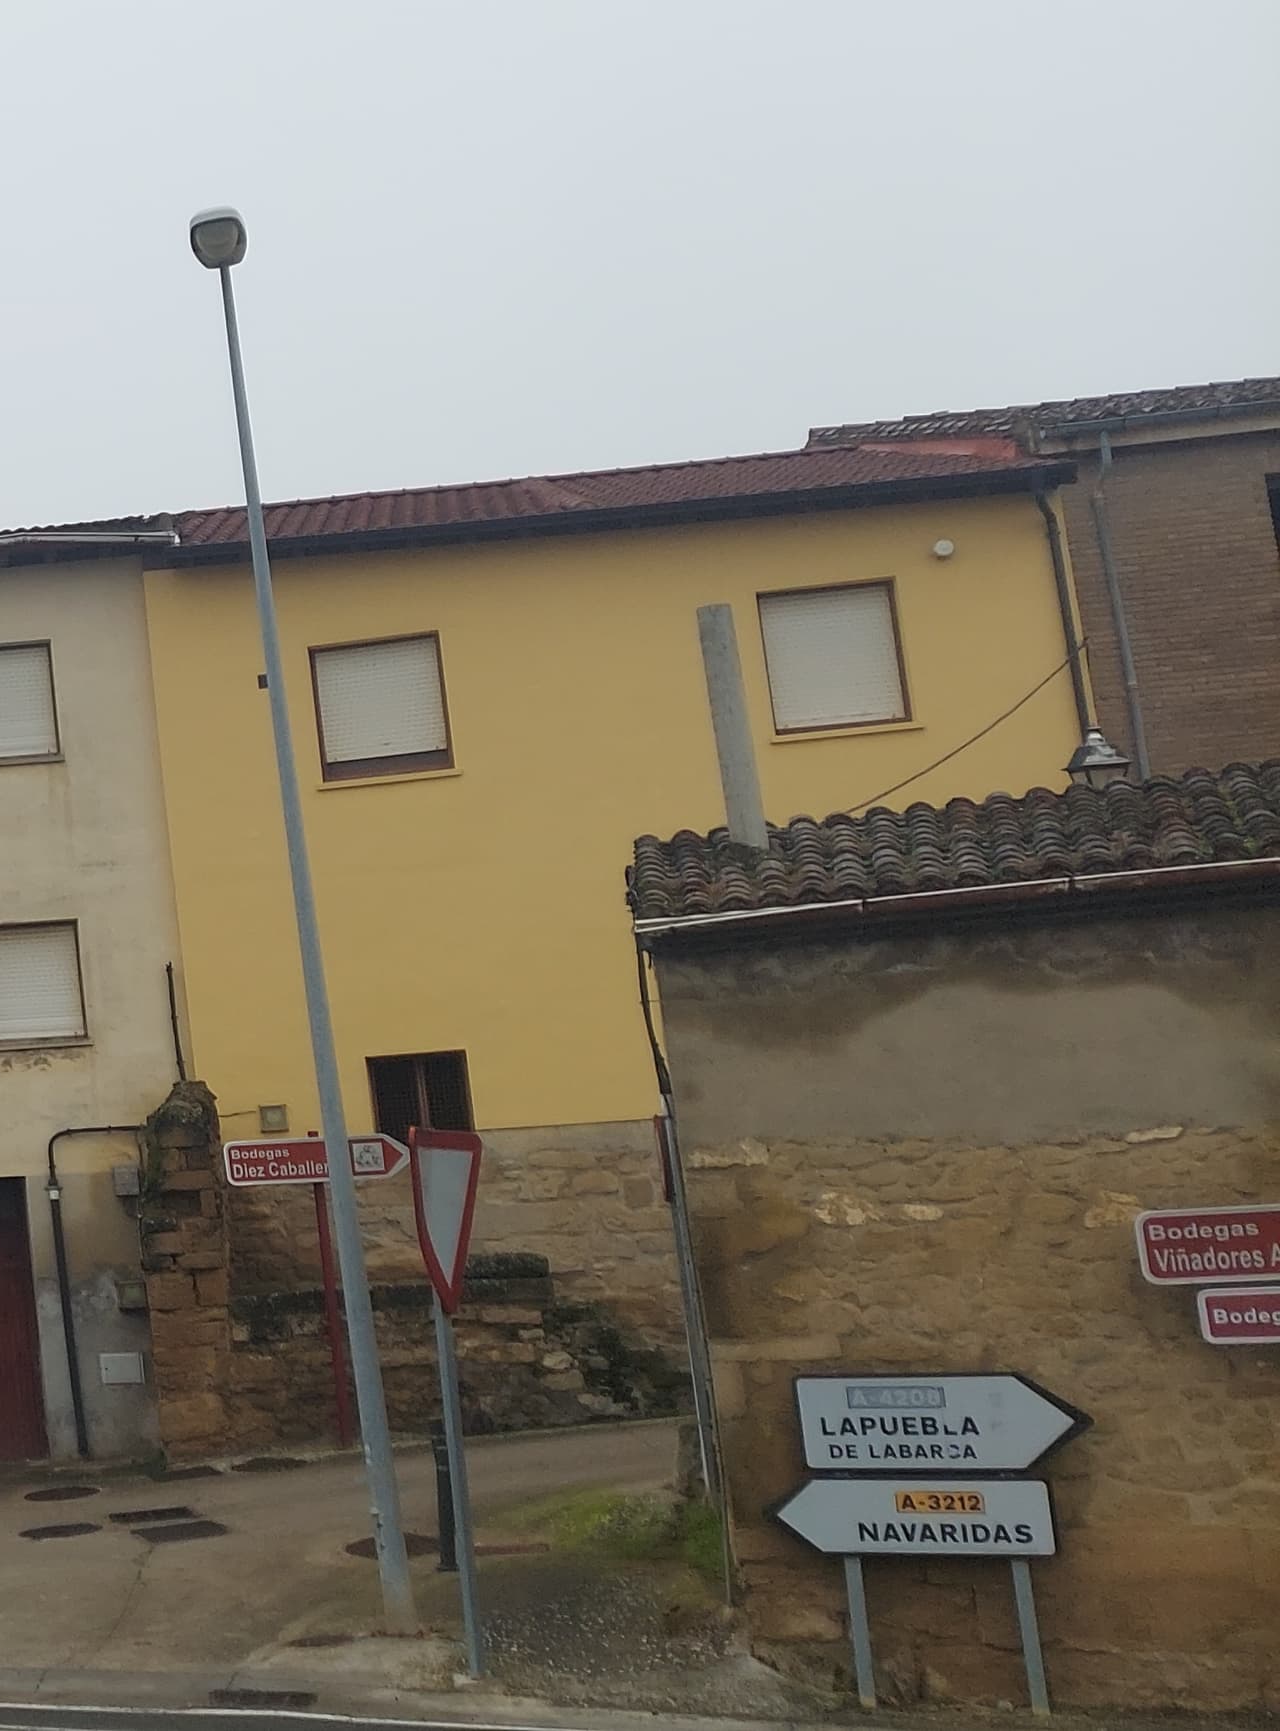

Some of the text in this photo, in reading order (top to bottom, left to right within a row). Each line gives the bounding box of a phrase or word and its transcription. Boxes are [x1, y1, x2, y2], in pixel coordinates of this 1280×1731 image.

[230, 1148, 290, 1160] Bodegas
[232, 1160, 329, 1179] Diez Caballer
[1148, 1222, 1259, 1241] Bodegas
[1153, 1246, 1265, 1272] Viñadores
[820, 1417, 980, 1437] LAPUEBLA
[829, 1444, 978, 1460] DE LABARCA
[901, 1495, 982, 1511] A-3212
[858, 1522, 1034, 1544] NAVARIDAS
